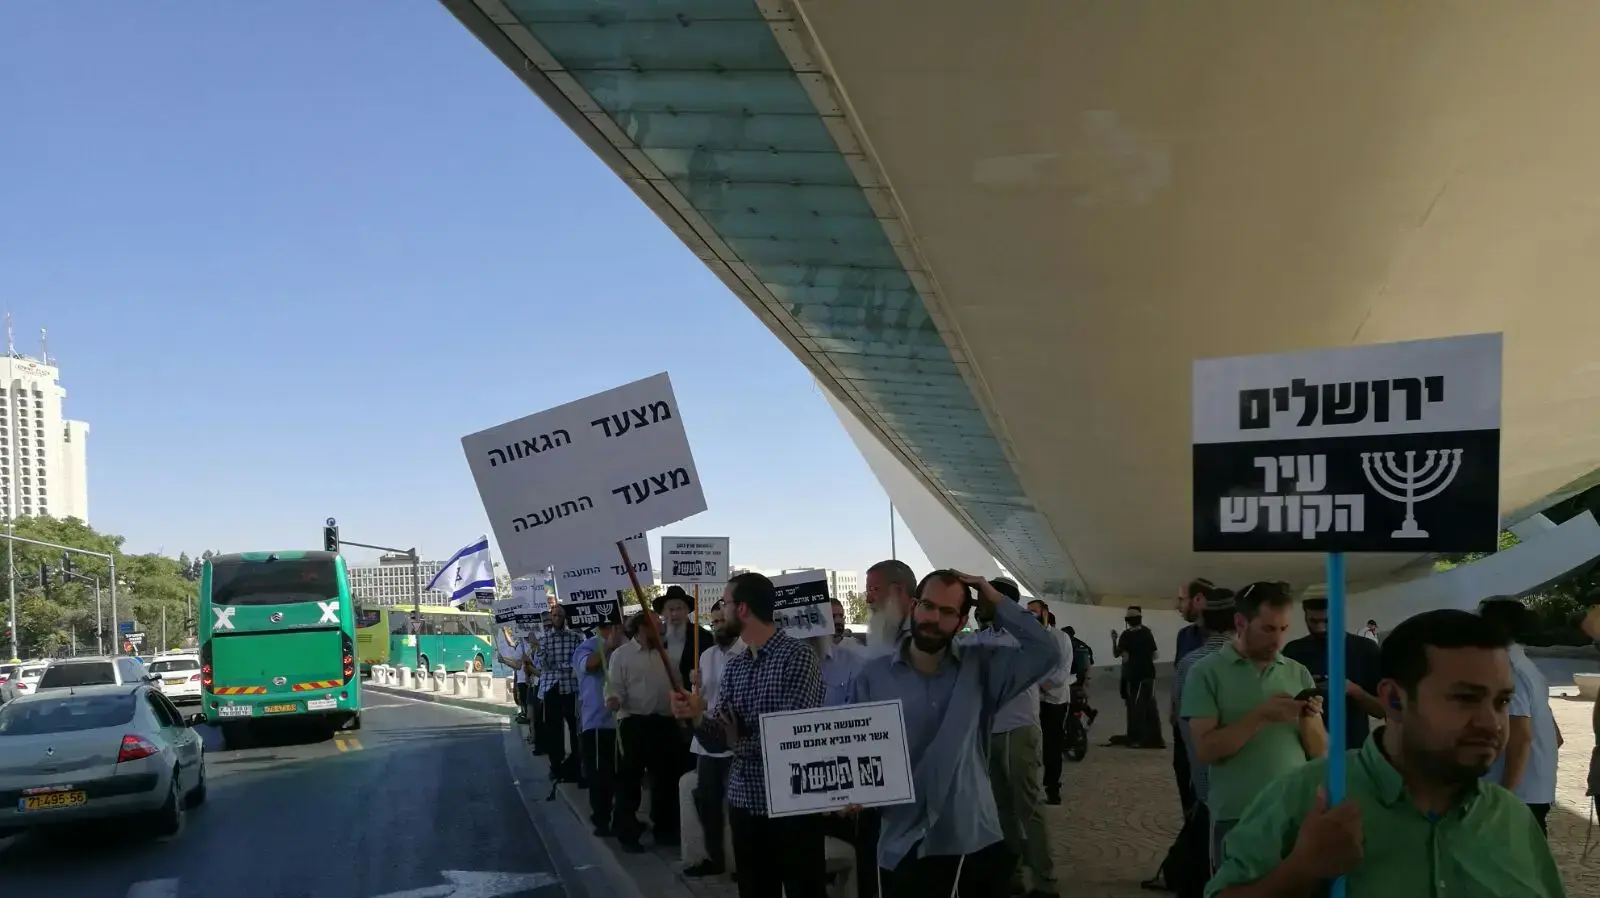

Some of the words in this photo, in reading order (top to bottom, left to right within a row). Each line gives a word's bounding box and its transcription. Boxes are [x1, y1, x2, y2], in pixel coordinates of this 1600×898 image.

[1240, 375, 1444, 429] ירושלים
[591, 400, 672, 438] מצעד
[488, 429, 571, 467] הגאווה
[1254, 454, 1326, 492] עיר
[612, 467, 690, 505] מצעד
[512, 496, 594, 533] התועבה
[1220, 494, 1364, 539] הקודש
[562, 566, 600, 579] התועבה
[570, 588, 607, 601] ירושלים
[576, 606, 591, 615] עיר
[571, 613, 600, 624] הקודש
[793, 724, 812, 735] כנען
[814, 721, 831, 733] ארץ
[829, 735, 851, 745] מביא
[853, 734, 867, 742] אני
[869, 730, 889, 740] אשר
[780, 741, 801, 750] שמה
[803, 738, 827, 748] אתכם
[857, 757, 884, 787] לא
